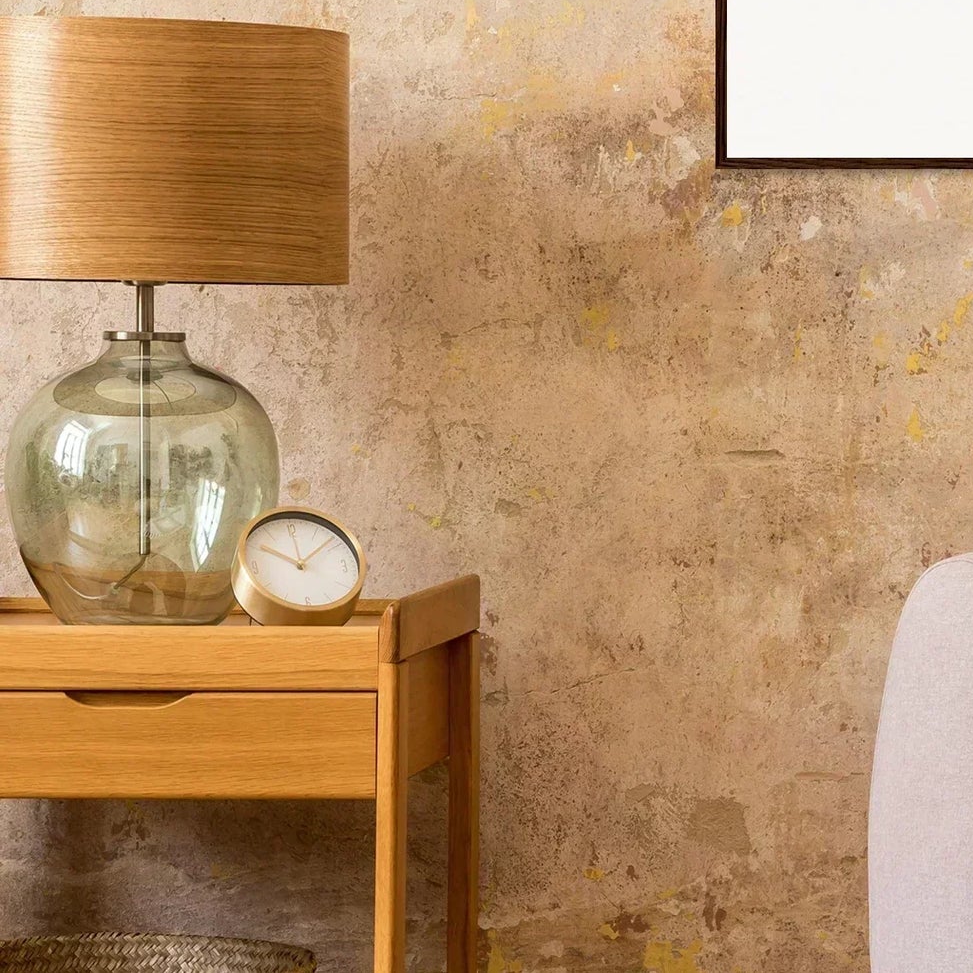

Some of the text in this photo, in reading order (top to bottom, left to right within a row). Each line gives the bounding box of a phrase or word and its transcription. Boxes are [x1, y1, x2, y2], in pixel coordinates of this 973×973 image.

[286, 524, 296, 536] 12
[251, 560, 258, 574] 9
[340, 560, 348, 572] 3
